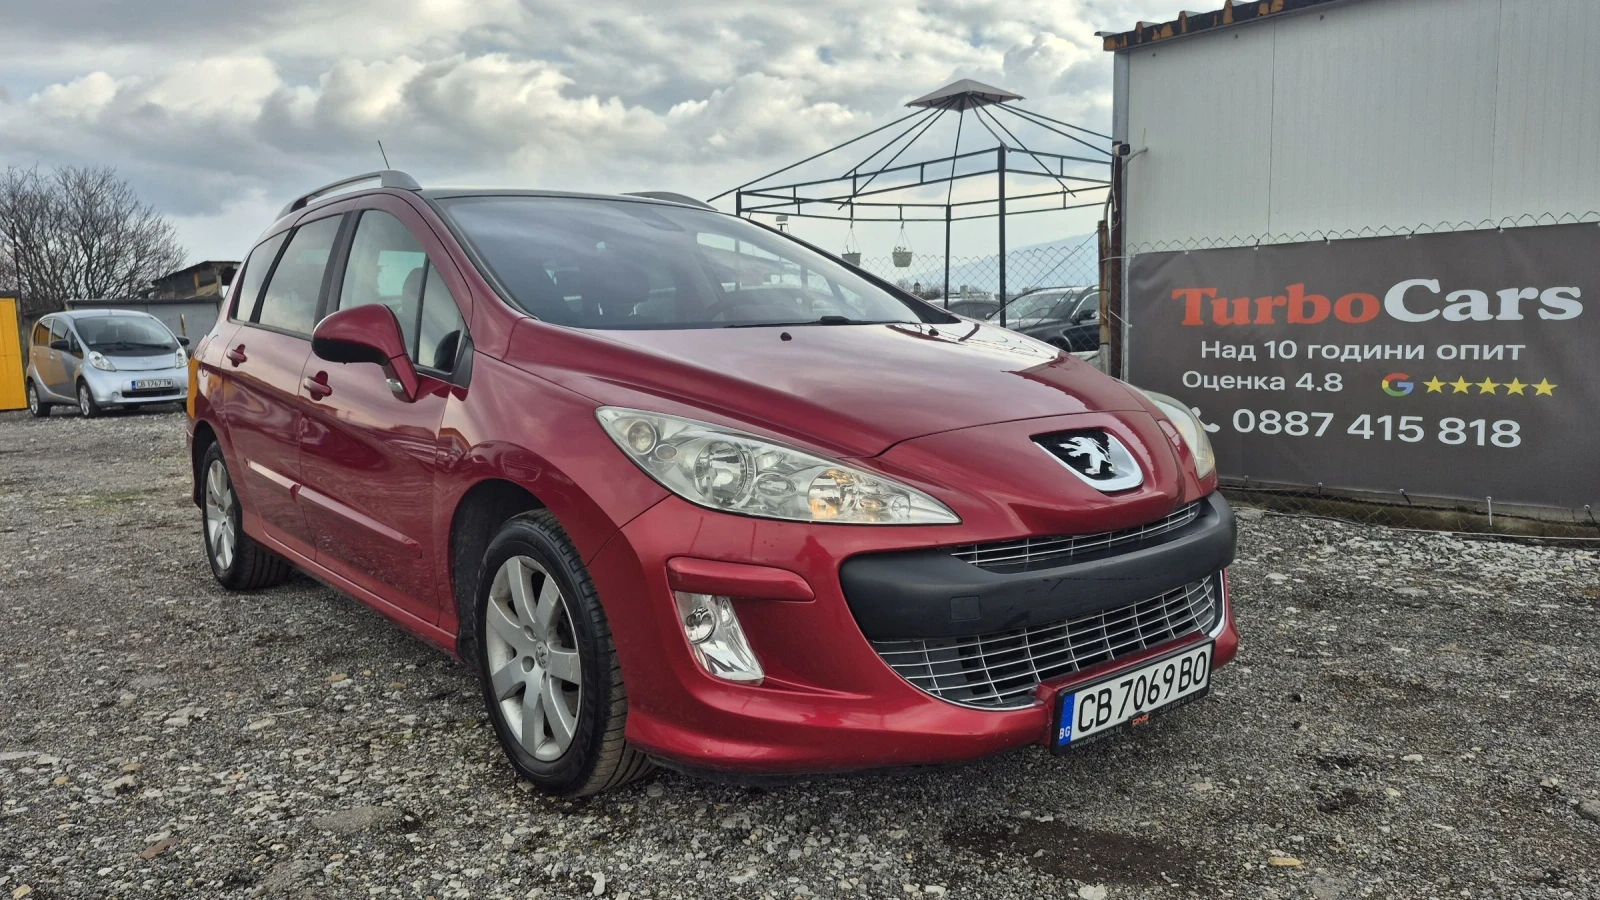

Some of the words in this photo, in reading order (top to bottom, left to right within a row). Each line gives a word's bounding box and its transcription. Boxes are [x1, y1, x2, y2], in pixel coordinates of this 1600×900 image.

[1171, 278, 1583, 326] TurboCars
[1201, 340, 1257, 362] Над
[1264, 340, 1298, 359] 10
[1307, 344, 1425, 363] години
[1436, 344, 1526, 361] опит
[1182, 370, 1286, 391] Оценка
[1295, 372, 1343, 392] 4.8
[1232, 408, 1334, 437] 0887
[1347, 413, 1425, 443] 415
[1437, 417, 1522, 448] 818
[1059, 725, 1071, 740] BG
